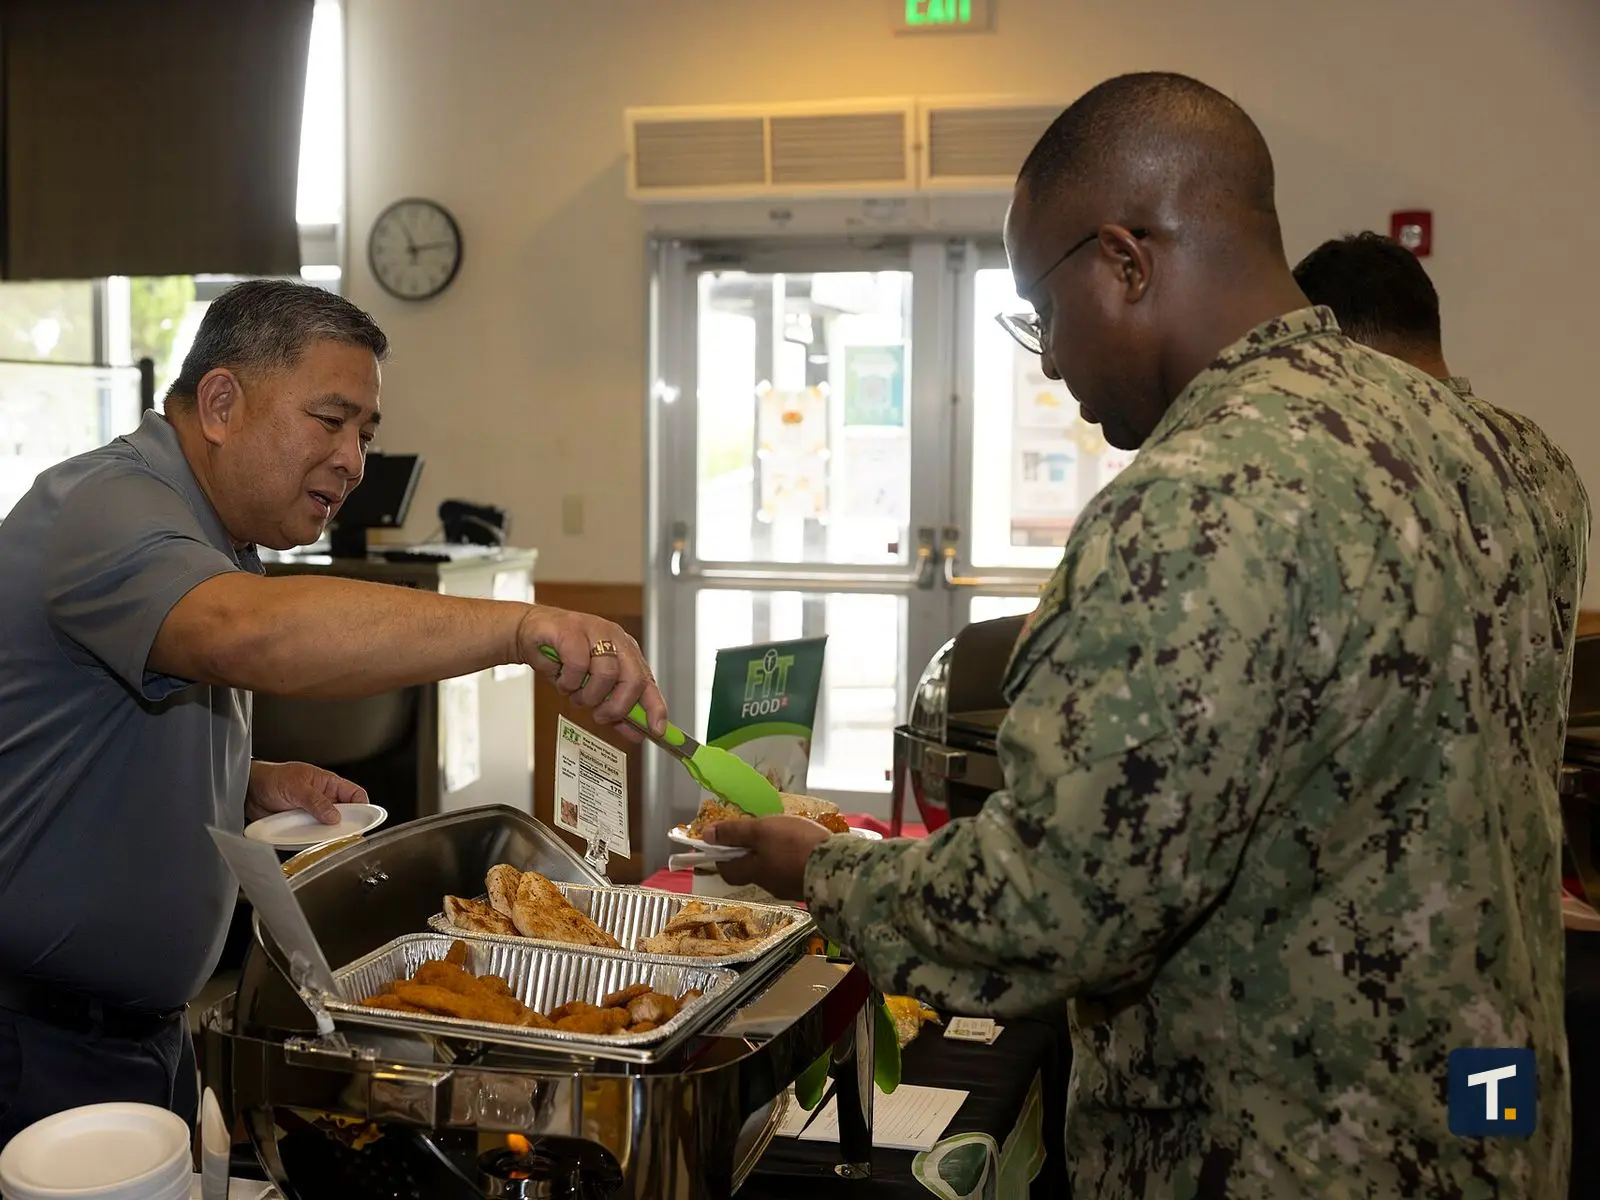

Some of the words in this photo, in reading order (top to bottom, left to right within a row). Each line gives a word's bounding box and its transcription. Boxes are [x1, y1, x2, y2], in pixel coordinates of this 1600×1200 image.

[744, 649, 795, 702] FIT
[580, 751, 603, 768] Nutrition
[609, 784, 623, 796] 170
